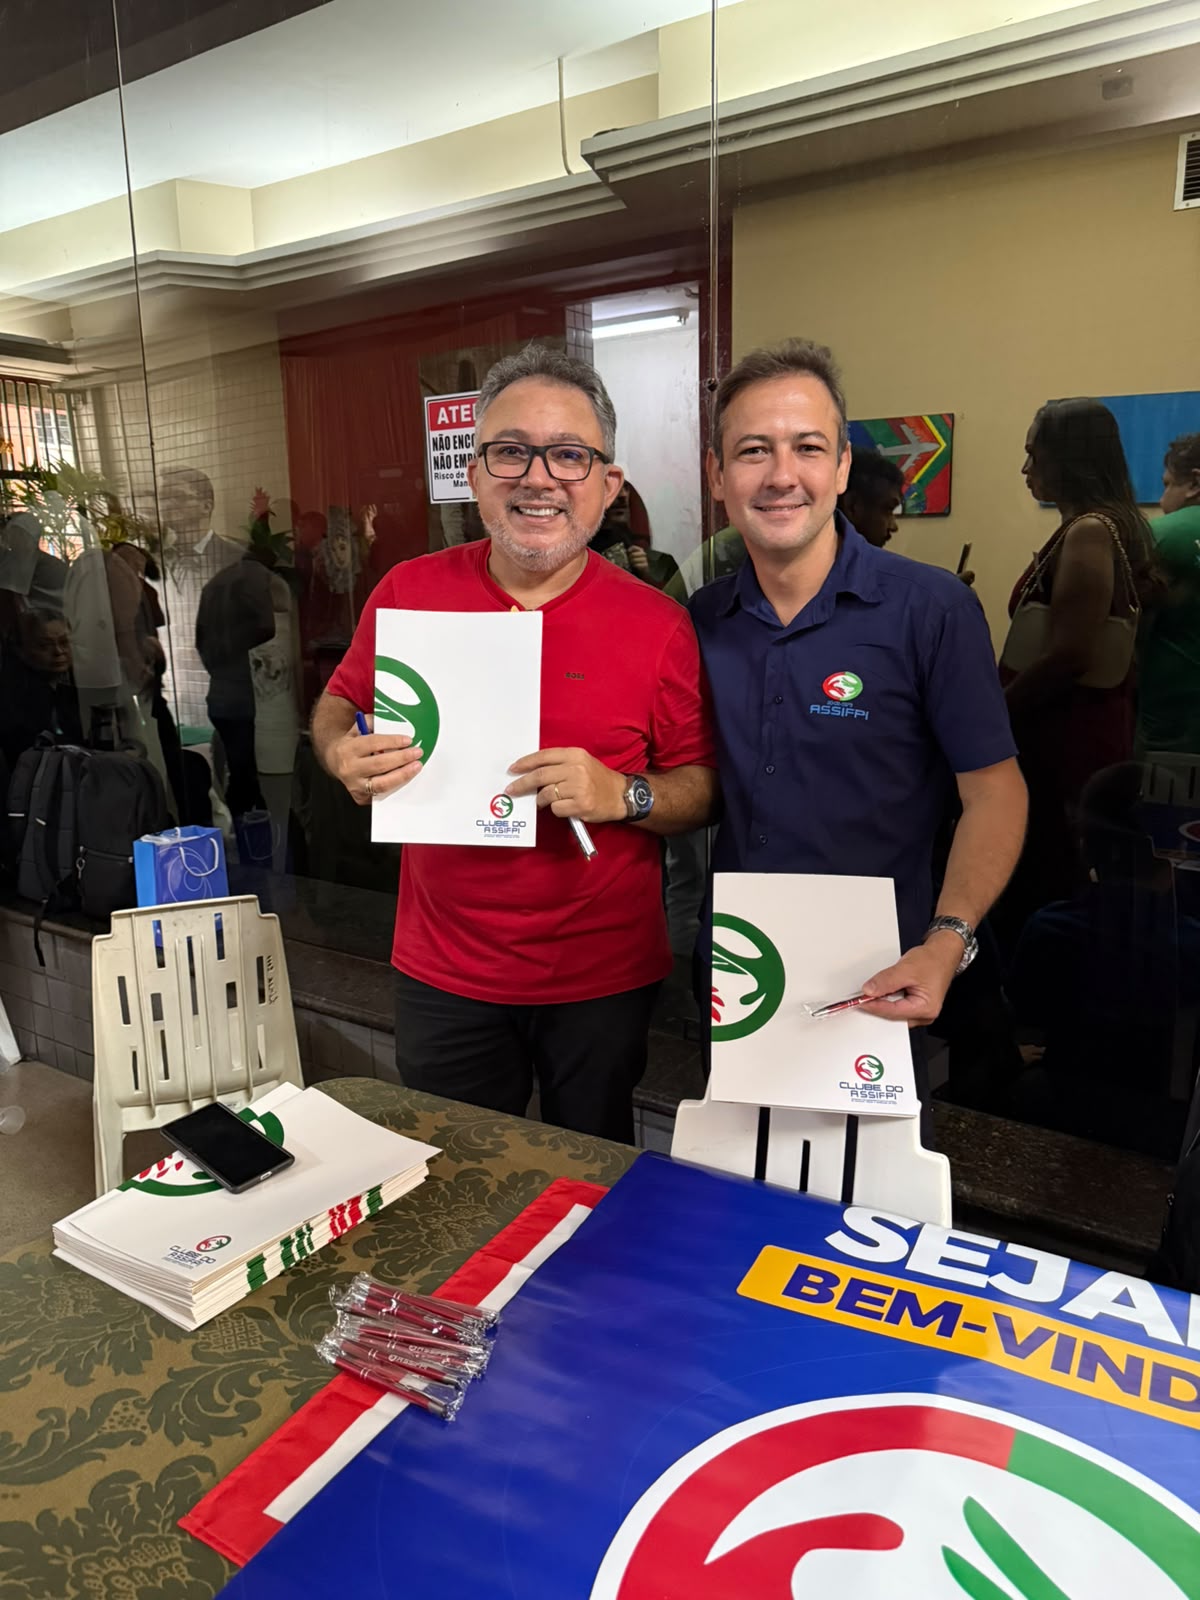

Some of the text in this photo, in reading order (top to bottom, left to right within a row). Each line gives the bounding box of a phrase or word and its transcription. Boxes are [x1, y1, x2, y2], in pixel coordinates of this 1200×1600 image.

[432, 434, 451, 452] NÃO
[433, 453, 452, 471] NÃO
[434, 472, 454, 480] Risco
[809, 704, 869, 721] ASSIFPI
[475, 819, 527, 828] CLUBE DO
[839, 1081, 904, 1093] CLUBE DO
[850, 1090, 897, 1100] ASSIFPI
[169, 1245, 202, 1259] CLUBE
[824, 1206, 1200, 1351] SEJA
